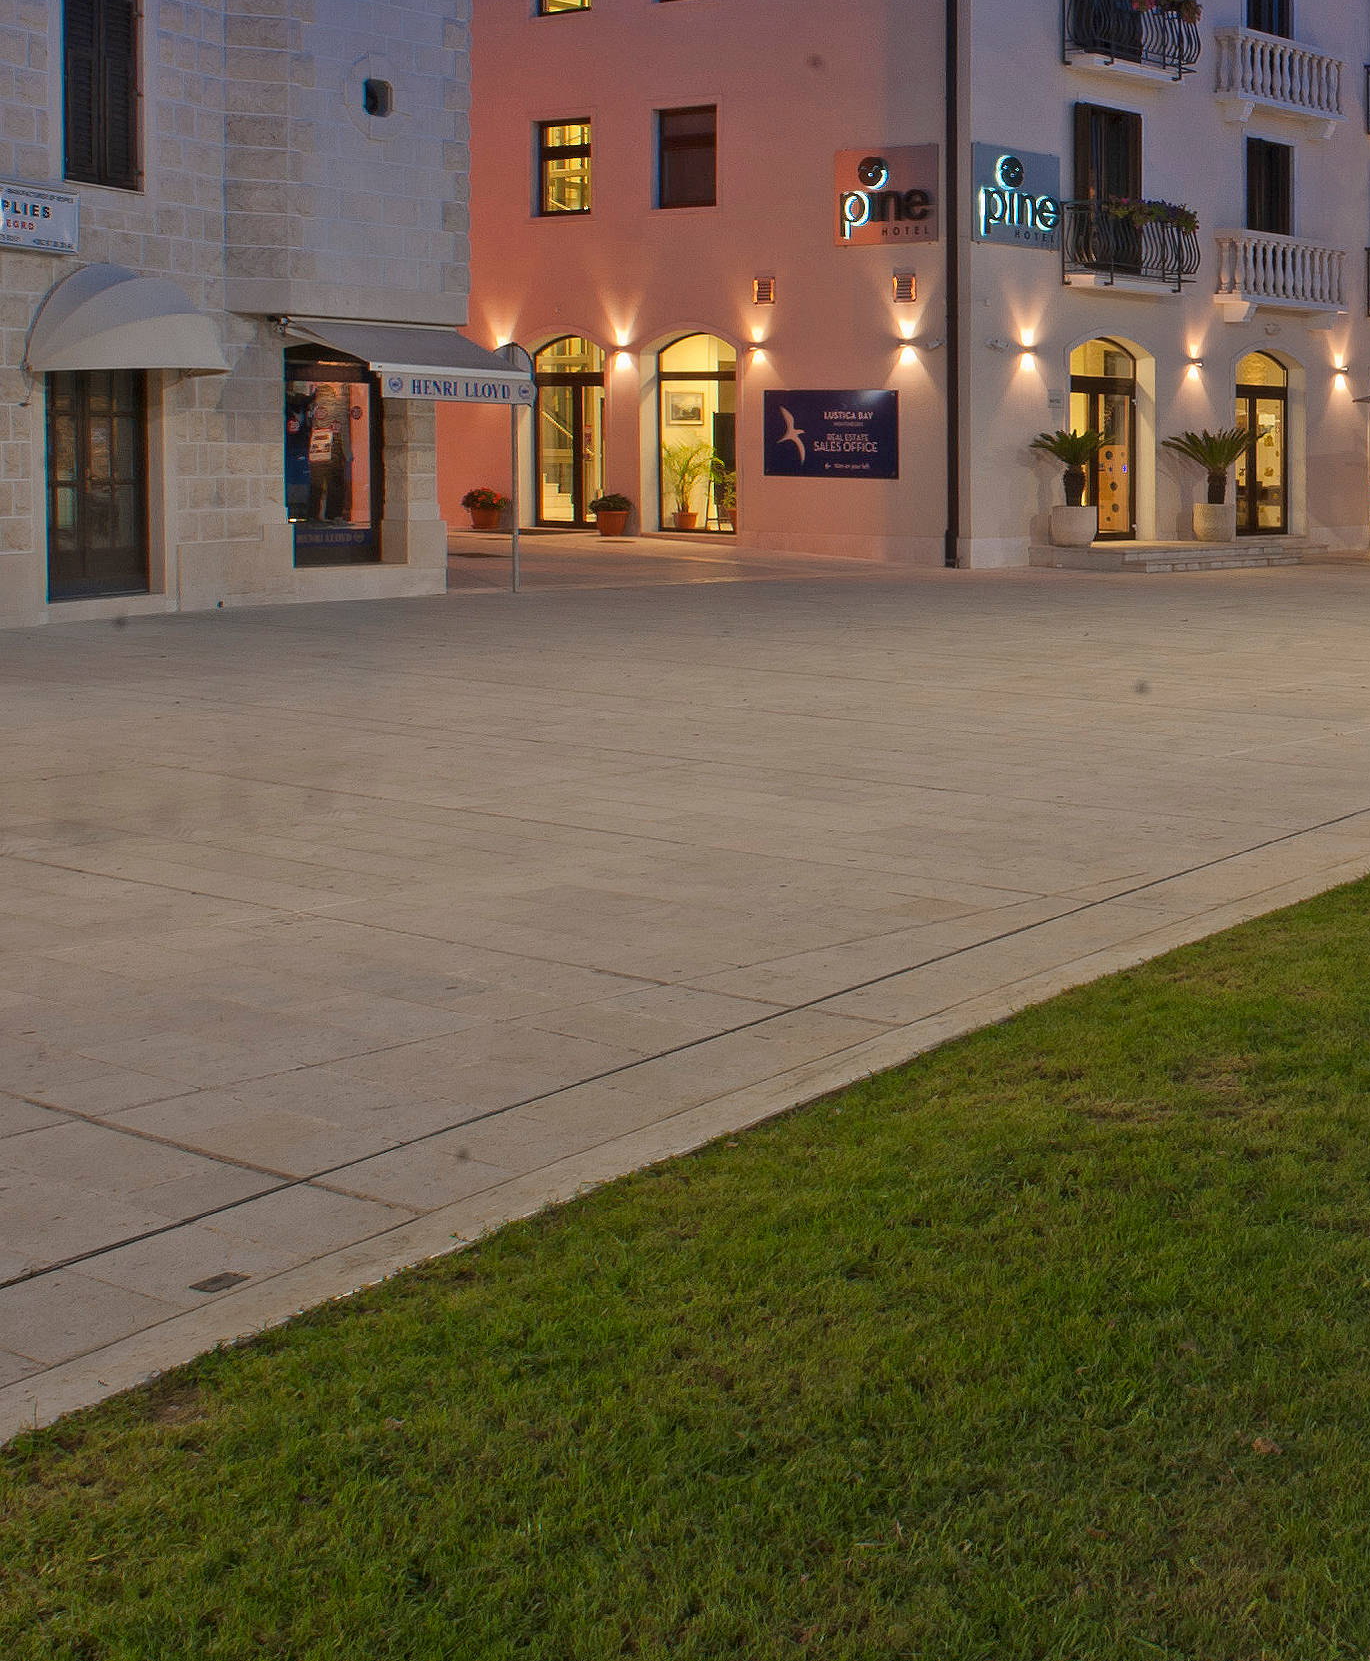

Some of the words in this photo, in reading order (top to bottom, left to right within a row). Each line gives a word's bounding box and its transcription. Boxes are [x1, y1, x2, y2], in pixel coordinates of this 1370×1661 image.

[840, 156, 931, 240] pine
[979, 154, 1061, 237] pine
[880, 225, 931, 237] HOTEL
[1014, 230, 1056, 243] HOTEL
[411, 379, 459, 397] HENRI
[464, 382, 512, 400] LLOYD
[814, 441, 841, 452] SALES
[843, 442, 878, 452] OFFICE
